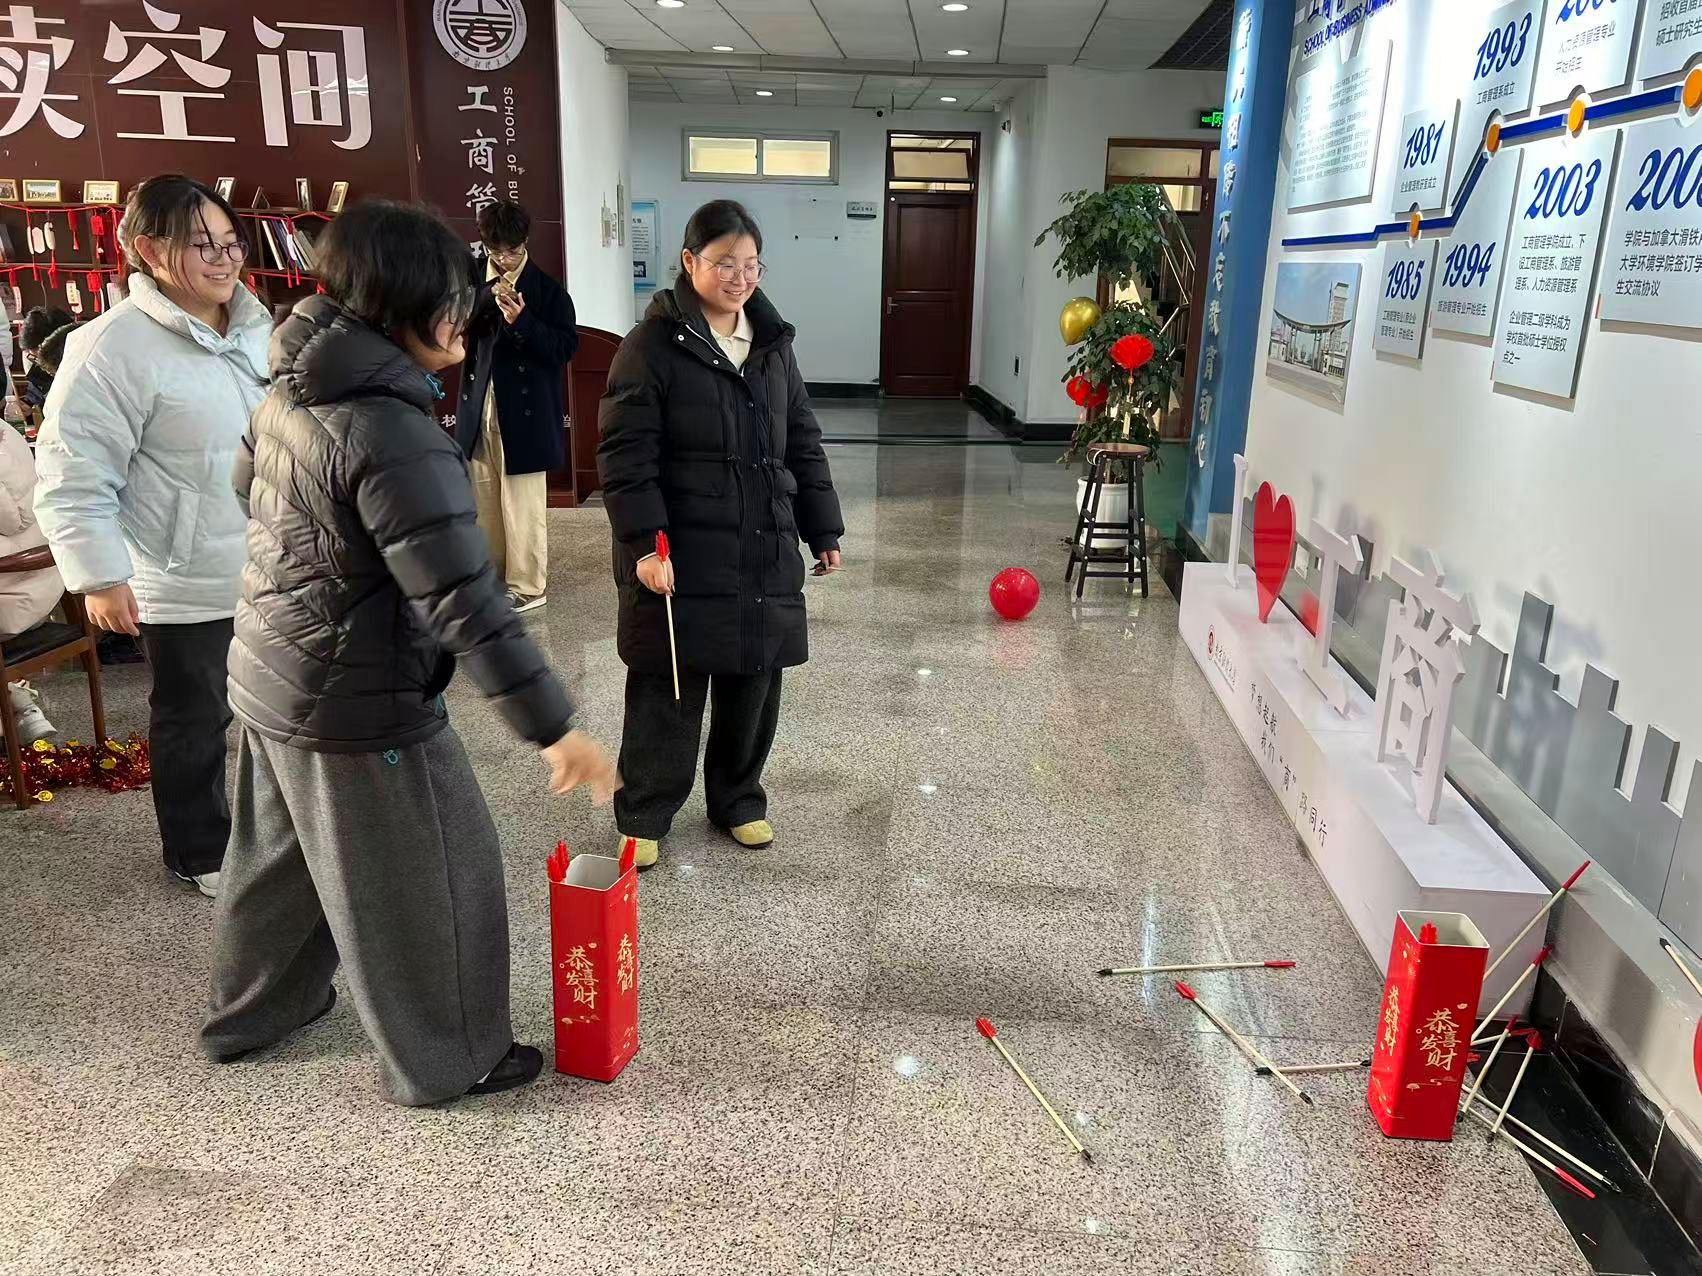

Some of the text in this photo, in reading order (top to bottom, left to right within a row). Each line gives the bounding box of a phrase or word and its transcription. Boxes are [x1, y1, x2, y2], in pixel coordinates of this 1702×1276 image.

[1474, 12, 1533, 81] 1993
[1656, 16, 1702, 46] 硕士研究生
[1476, 81, 1516, 105] 工商管理系成立
[503, 87, 516, 146] SCHOOL
[506, 154, 517, 173] OF
[1403, 120, 1446, 169] 1981
[1523, 158, 1602, 220] 2003
[1625, 143, 1702, 212] 200
[1624, 227, 1702, 248] 学院与加拿大滑铁
[1385, 260, 1425, 300] 1985
[1442, 242, 1496, 288] 1994
[1619, 254, 1702, 273] 大学环境学院签订学
[1615, 278, 1661, 297] 生交流协议
[1503, 350, 1521, 364] 点之一
[564, 945, 599, 1009] 恭喜发财
[1420, 1008, 1462, 1071] 恭喜发财
